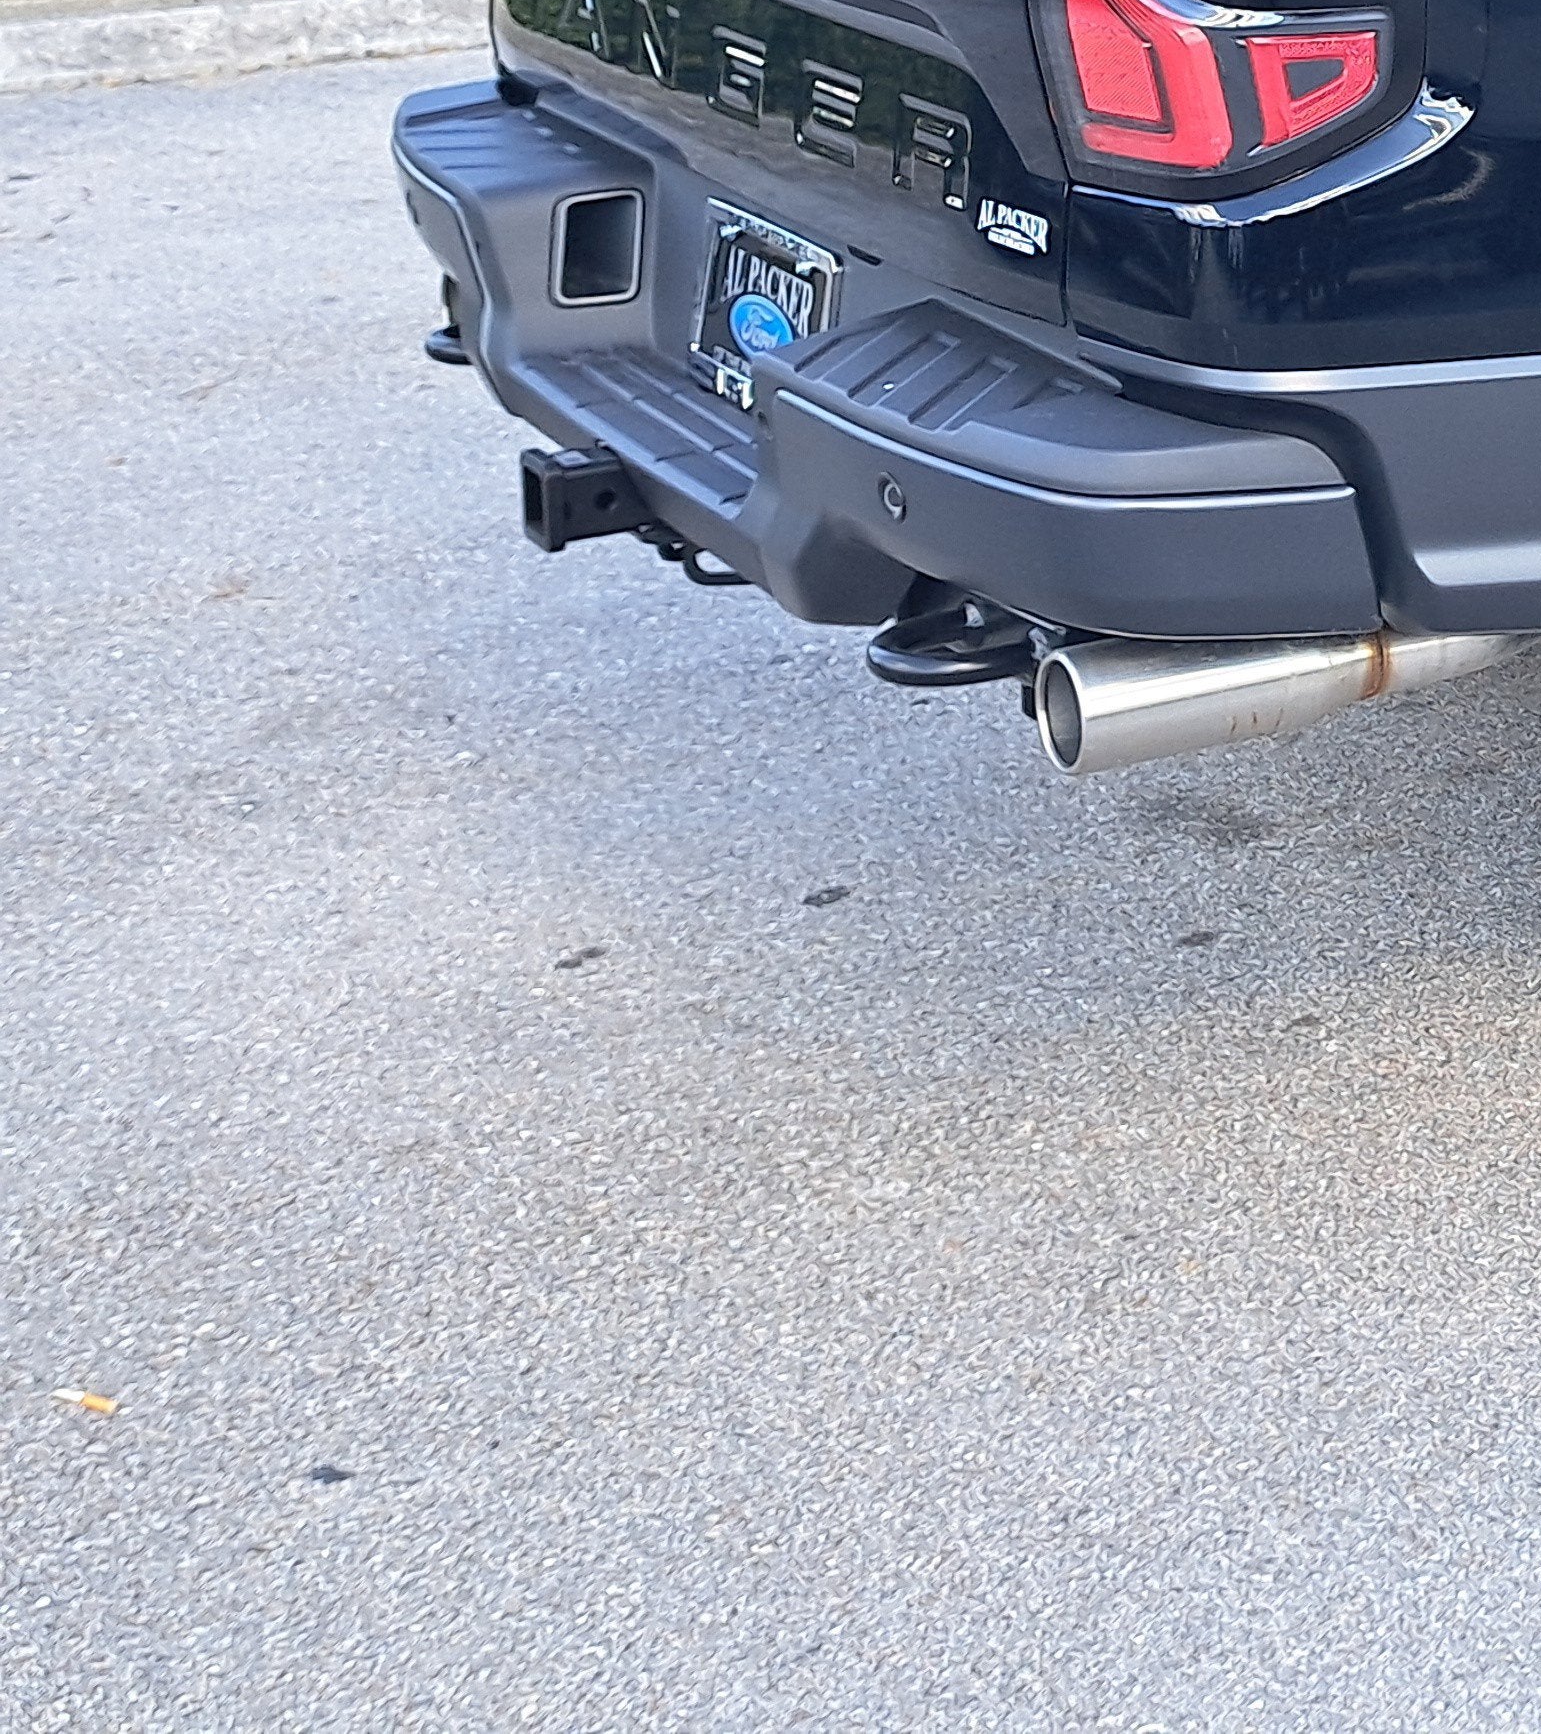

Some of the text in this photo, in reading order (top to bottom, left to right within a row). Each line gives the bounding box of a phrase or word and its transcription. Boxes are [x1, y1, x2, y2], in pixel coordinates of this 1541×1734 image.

[977, 198, 996, 231] AL
[997, 203, 1049, 254] PACKER
[720, 244, 814, 341] AL PACKER
[739, 306, 783, 351] Ford
